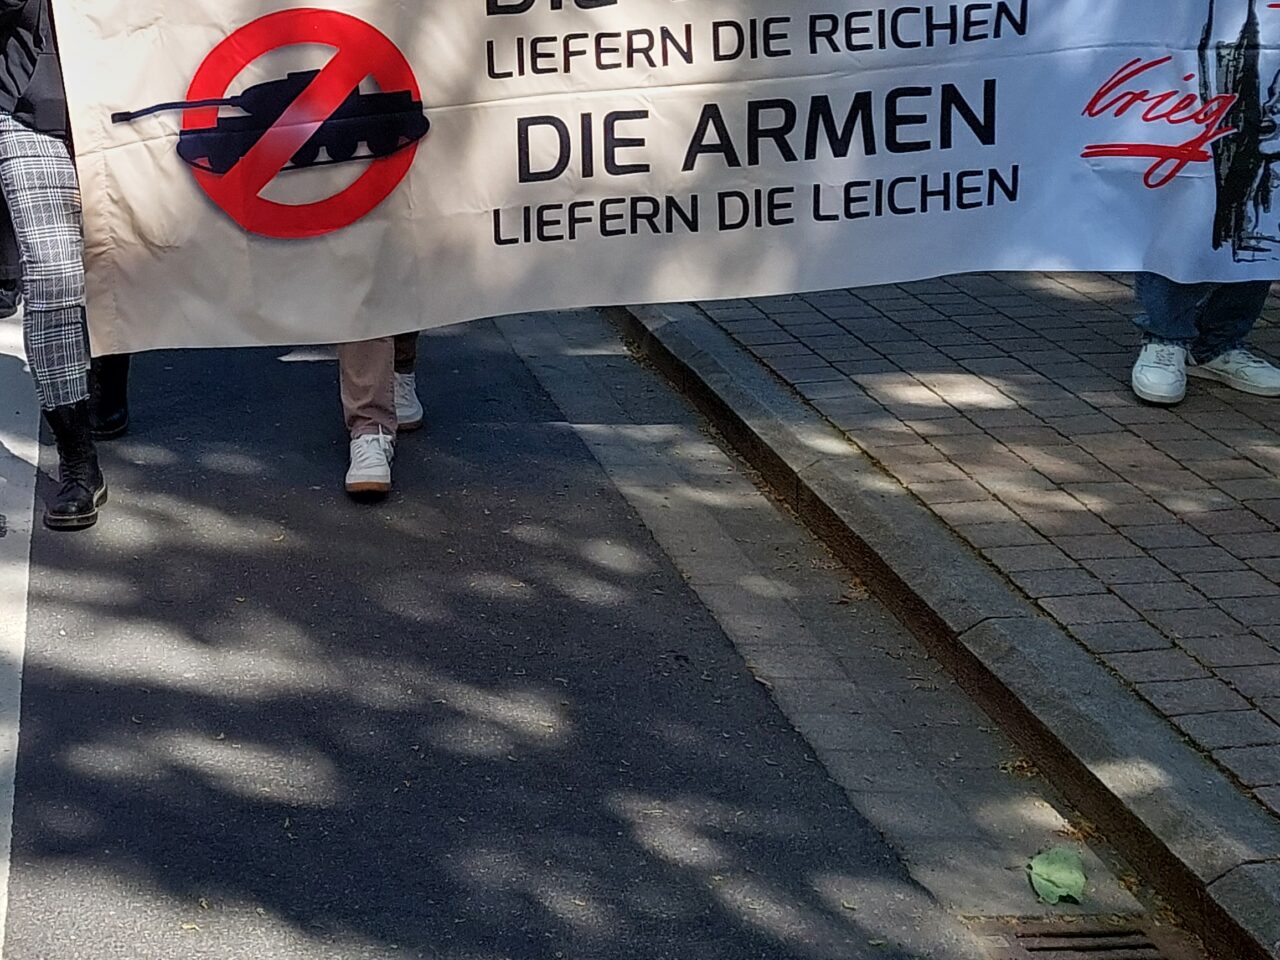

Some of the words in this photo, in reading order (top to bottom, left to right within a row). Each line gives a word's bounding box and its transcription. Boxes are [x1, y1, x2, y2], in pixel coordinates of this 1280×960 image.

[485, 23, 694, 80] LIEFERN
[712, 16, 792, 63] DIE
[515, 109, 651, 184] DIE
[680, 77, 997, 174] ARMEN
[1082, 55, 1239, 190] Krieg
[491, 193, 699, 247] LIEFERN
[717, 186, 795, 232] DIE
[811, 164, 1021, 223] LEICHEN
